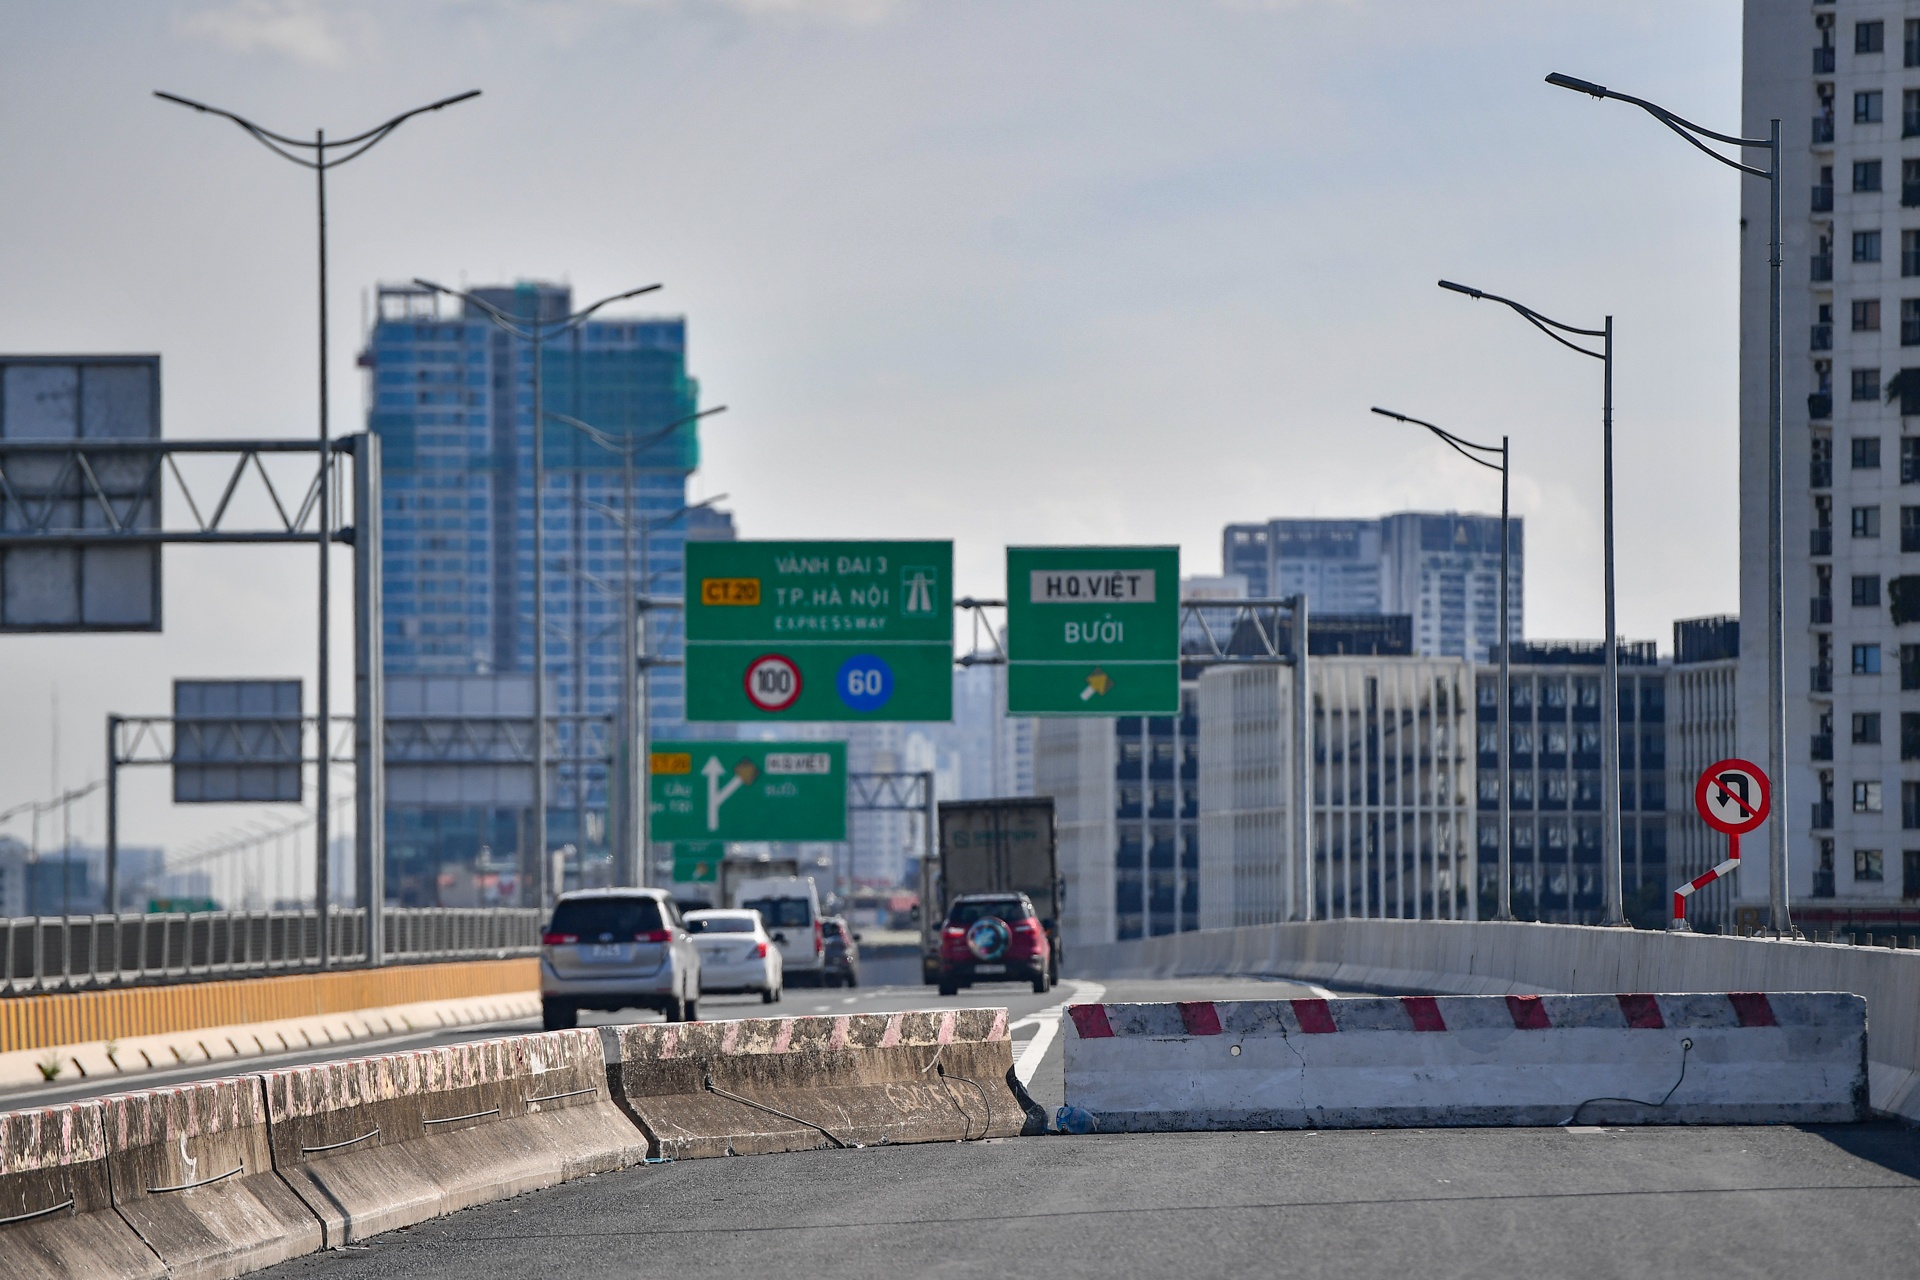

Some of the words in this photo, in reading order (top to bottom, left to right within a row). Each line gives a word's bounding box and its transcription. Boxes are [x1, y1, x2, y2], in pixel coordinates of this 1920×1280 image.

[876, 556, 888, 574] 3
[758, 668, 791, 694] 100
[847, 669, 883, 695] 60
